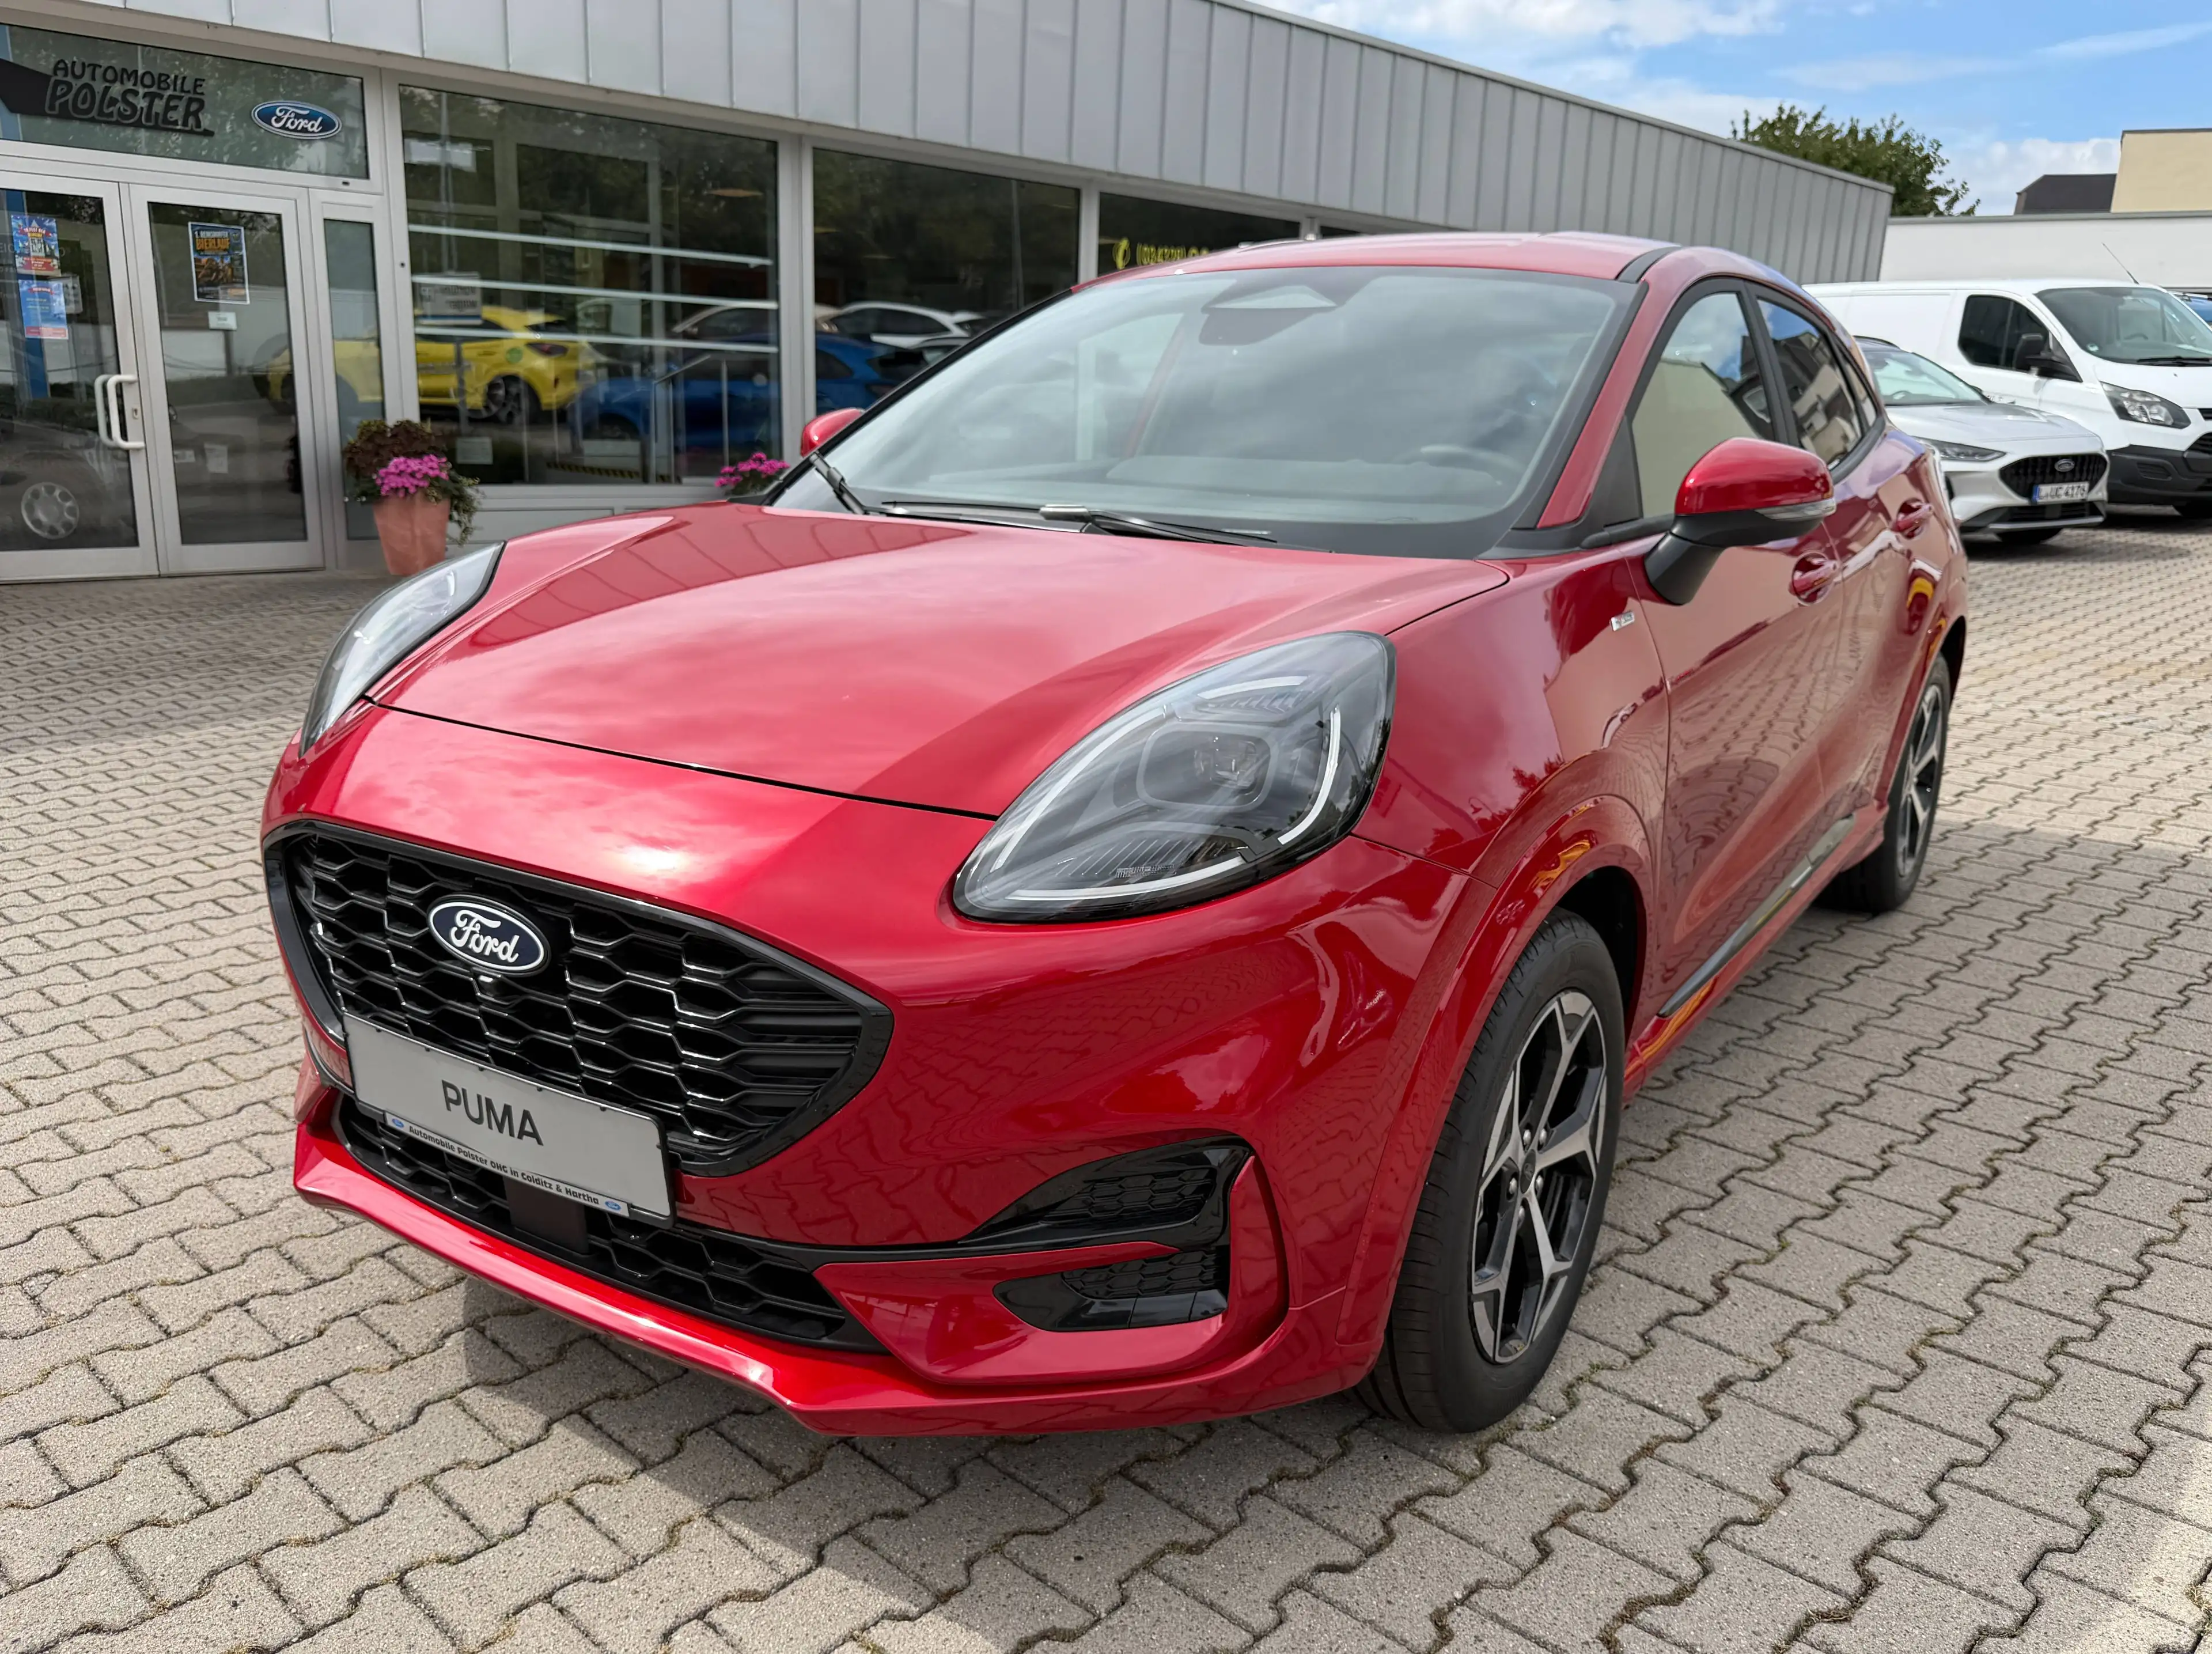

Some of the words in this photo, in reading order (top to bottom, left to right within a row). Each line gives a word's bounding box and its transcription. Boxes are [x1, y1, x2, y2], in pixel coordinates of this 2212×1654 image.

[46, 76, 206, 131] POLSTER
[53, 59, 206, 96] AUTOMOBILE
[271, 106, 324, 133] Ford
[450, 910, 520, 963] Ford
[441, 1079, 544, 1146] PUMA
[409, 1125, 456, 1152] Automobile
[457, 1146, 488, 1165] Polster
[490, 1160, 508, 1174] OHG
[510, 1167, 519, 1178] in
[521, 1172, 553, 1190] Colditz
[556, 1184, 563, 1193] &
[565, 1187, 600, 1205] Hartha
